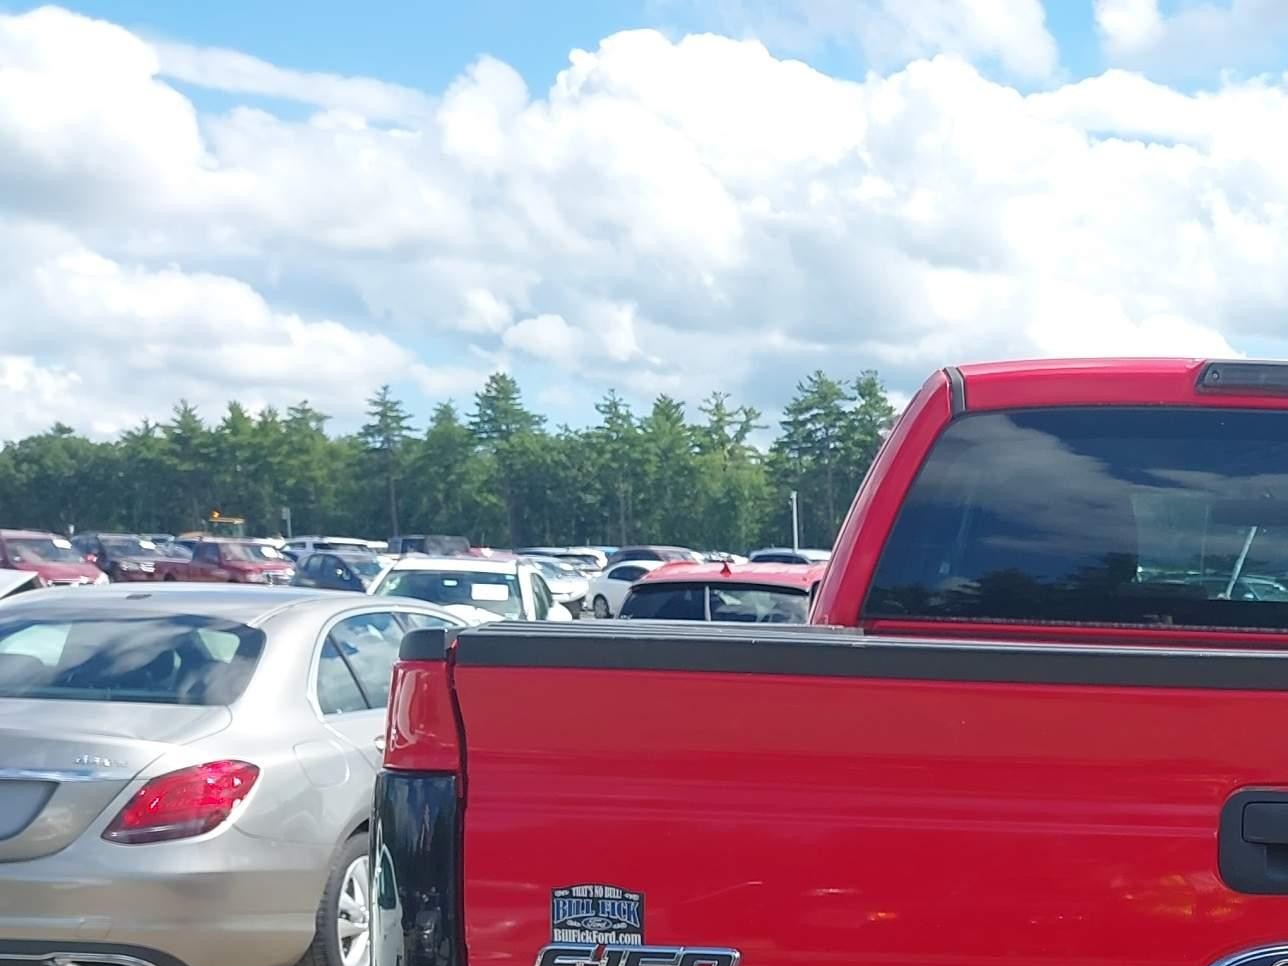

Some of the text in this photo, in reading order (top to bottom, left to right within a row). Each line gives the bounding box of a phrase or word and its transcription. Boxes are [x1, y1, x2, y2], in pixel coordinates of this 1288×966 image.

[594, 886, 603, 898] NO
[553, 898, 640, 928] BILL FICK
[553, 928, 641, 945] BillFickFord.com
